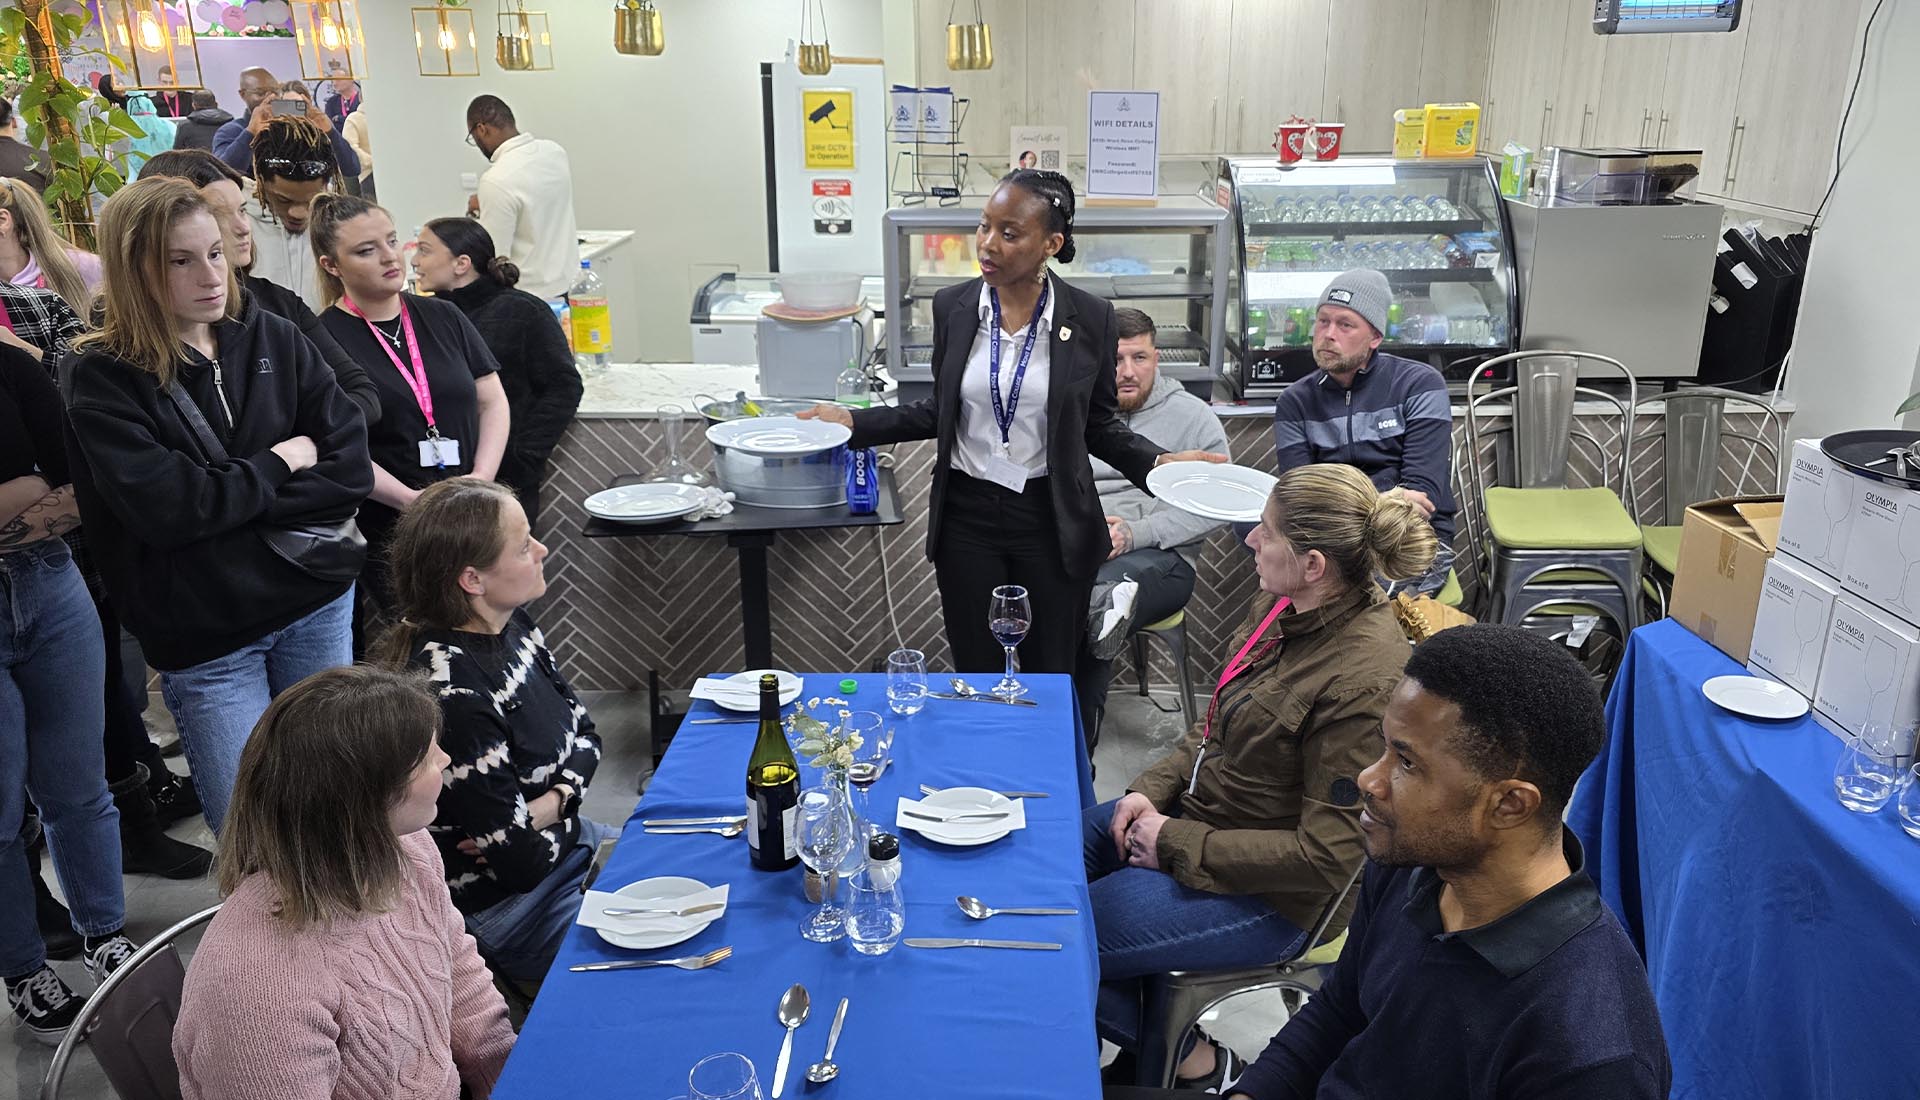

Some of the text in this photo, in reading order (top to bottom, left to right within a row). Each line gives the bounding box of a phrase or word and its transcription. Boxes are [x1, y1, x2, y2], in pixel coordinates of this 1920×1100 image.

[1093, 120, 1154, 129] WIFI DETAILS
[816, 152, 849, 161] Operation
[856, 449, 866, 486] BOOS
[1796, 458, 1824, 476] OLYMPIA
[1865, 491, 1898, 512] OLYMPIA
[1768, 576, 1794, 596] OLYMPIA
[1836, 618, 1865, 642] OLYMPIA
